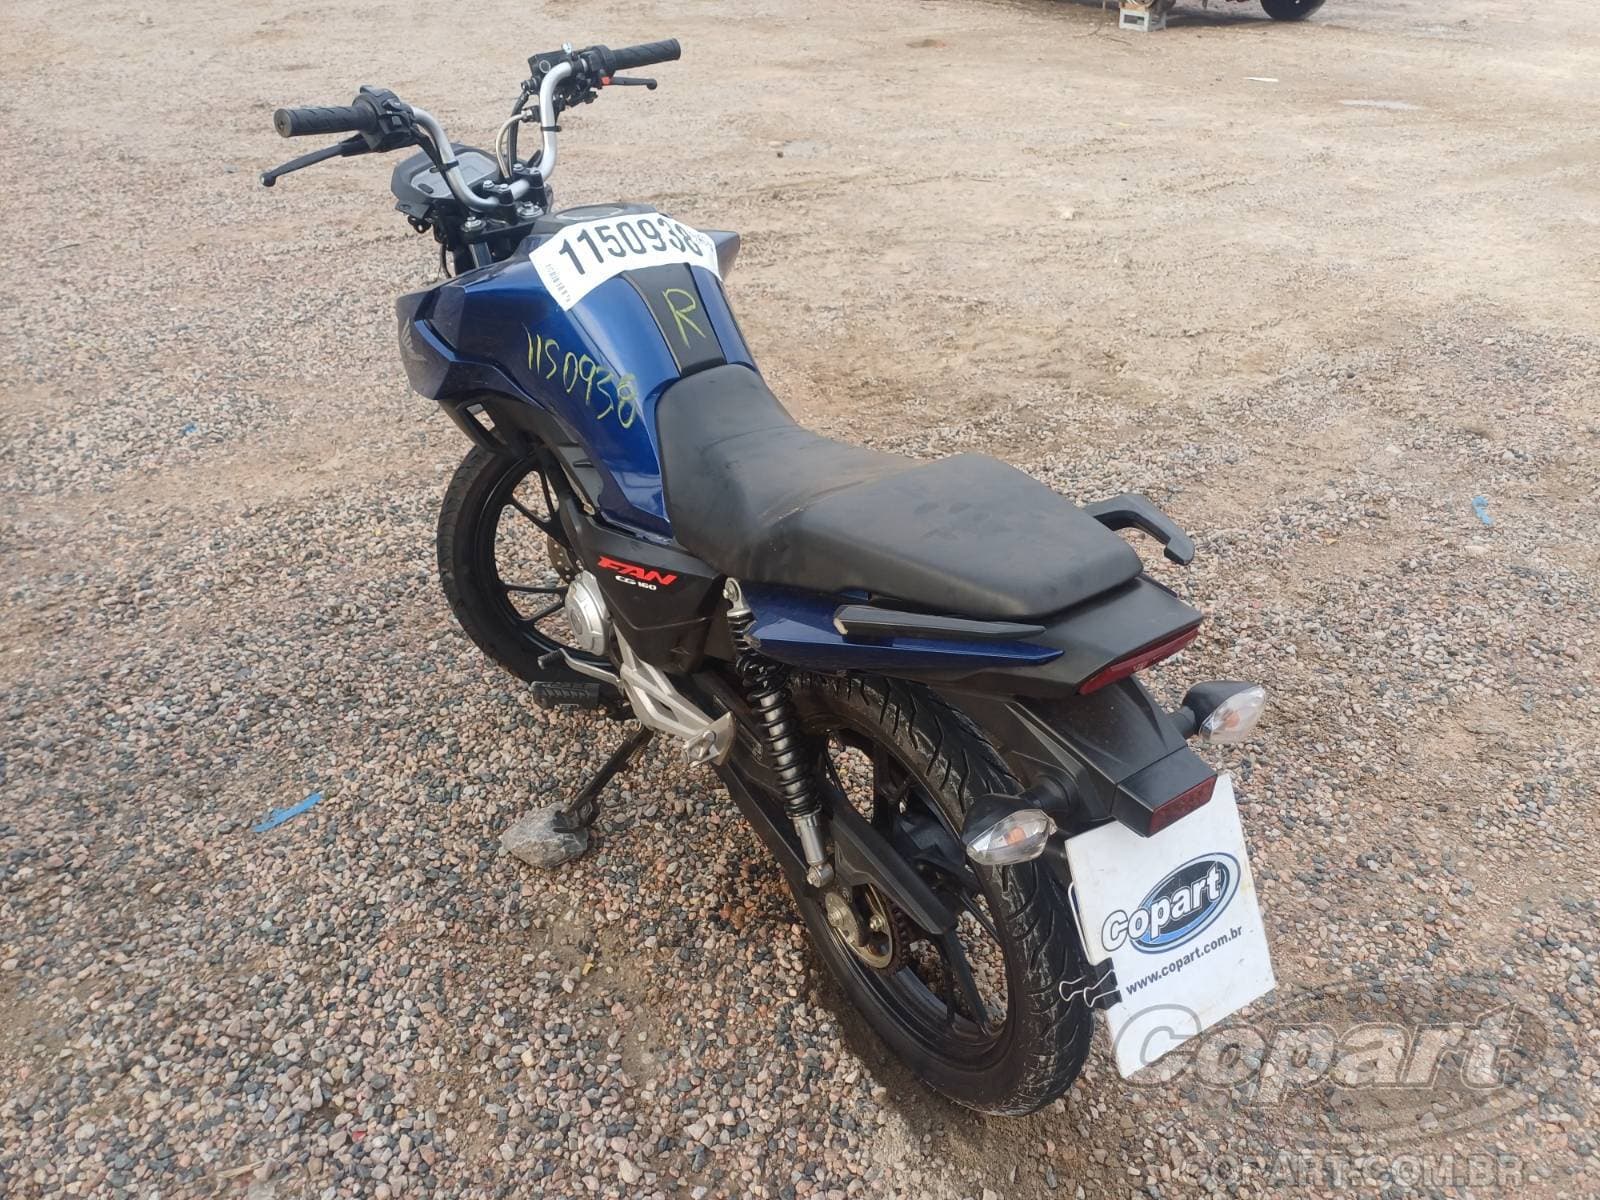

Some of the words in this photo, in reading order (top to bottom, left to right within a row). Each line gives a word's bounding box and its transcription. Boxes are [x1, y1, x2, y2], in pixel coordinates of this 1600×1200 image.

[559, 218, 703, 275] 1150938
[663, 288, 706, 348] R
[598, 556, 677, 585] FAN
[615, 575, 637, 585] CG
[637, 581, 657, 591] 160
[1101, 863, 1221, 952] Copart
[1126, 925, 1243, 995] www.copart.com.br
